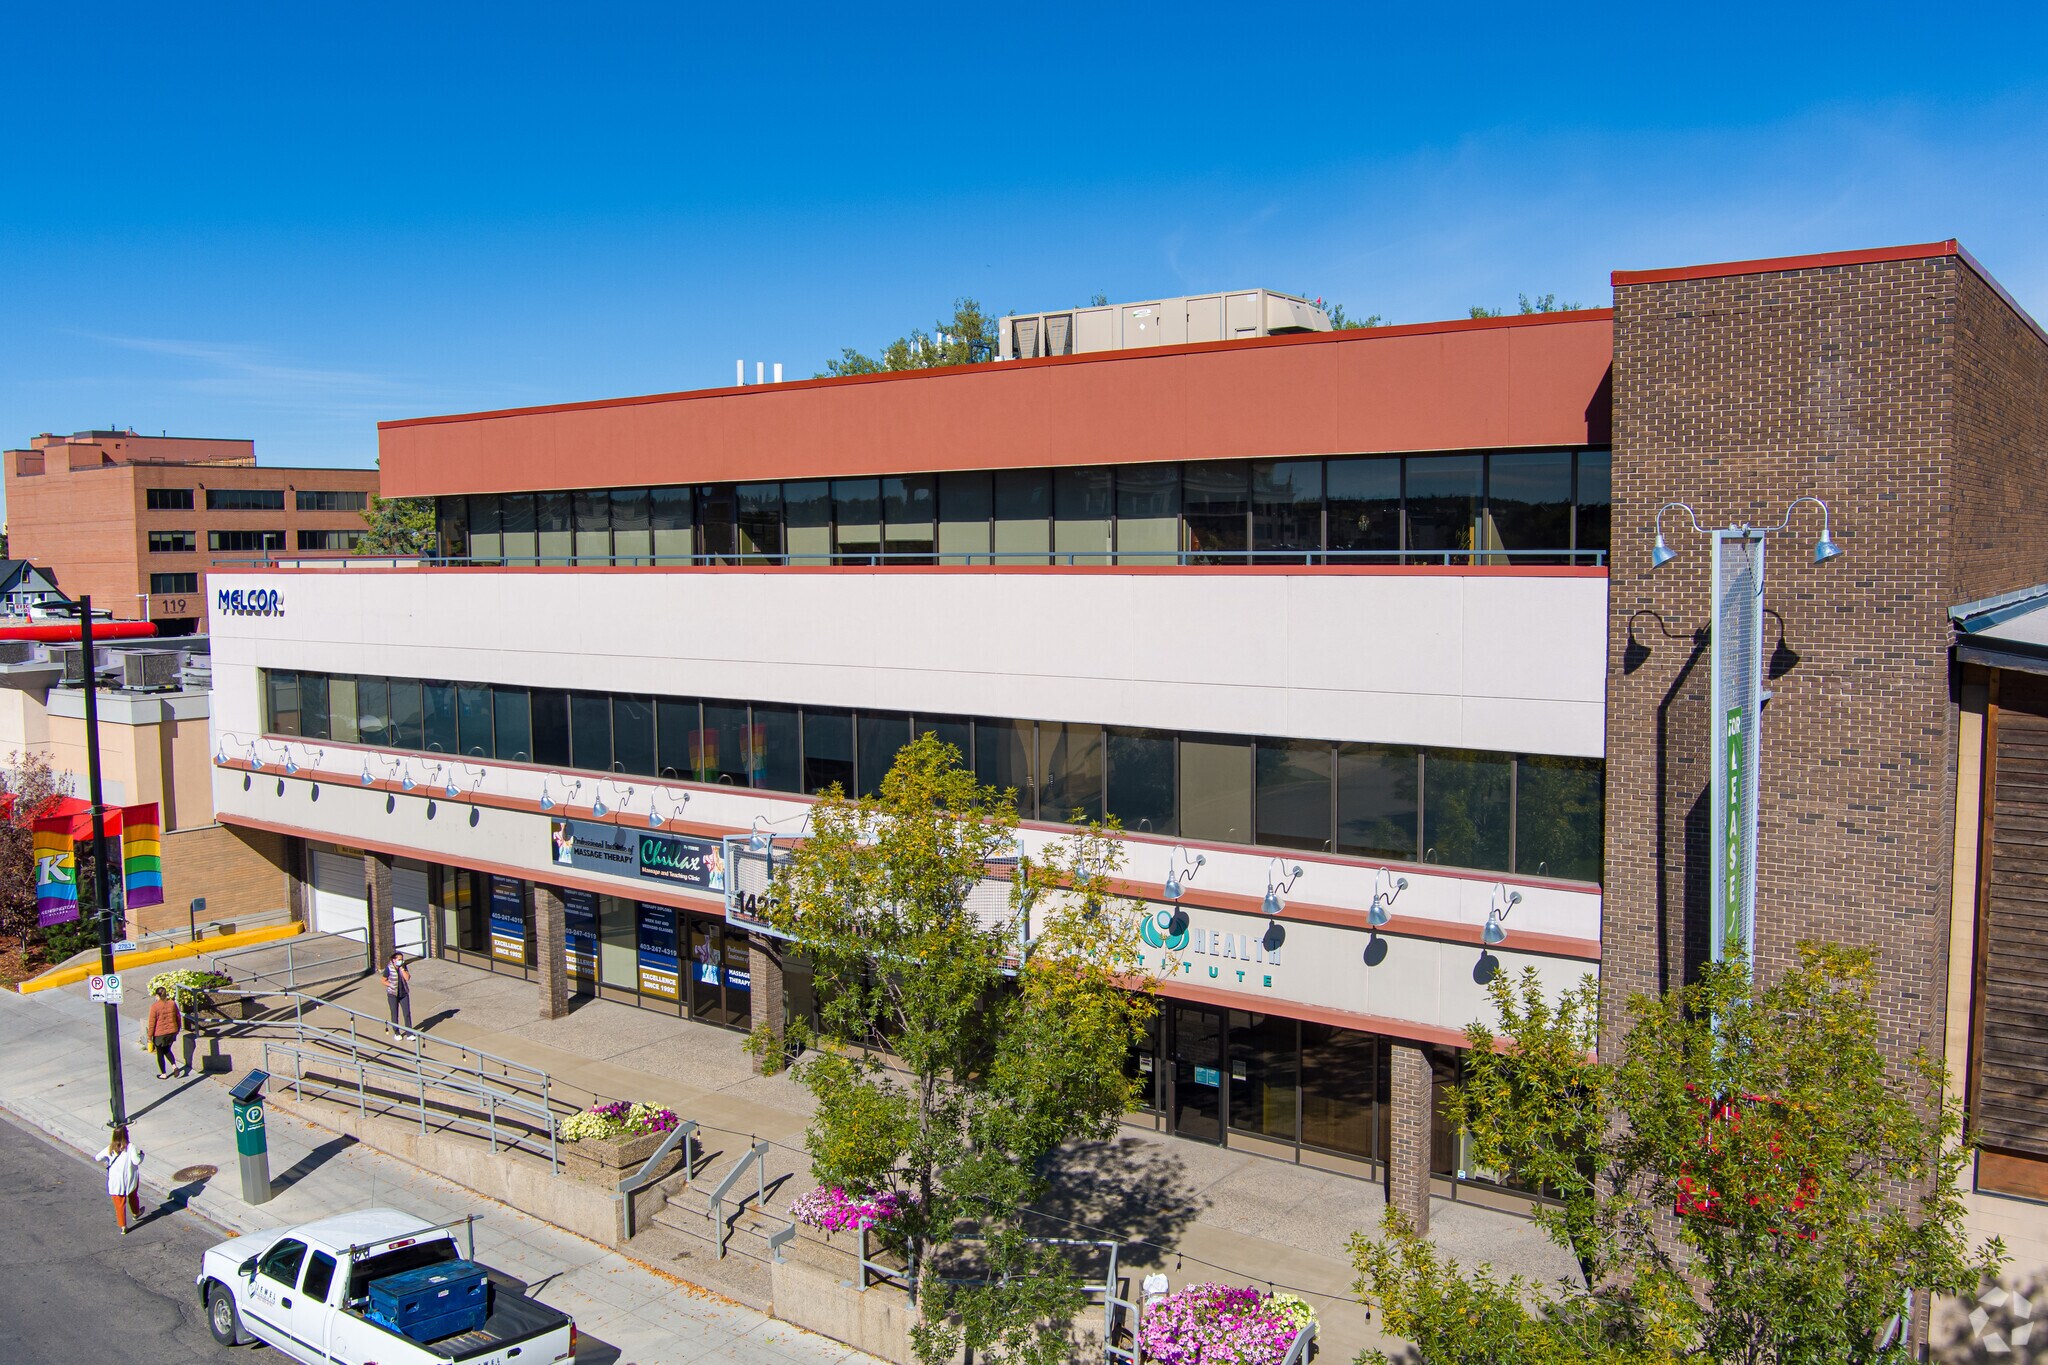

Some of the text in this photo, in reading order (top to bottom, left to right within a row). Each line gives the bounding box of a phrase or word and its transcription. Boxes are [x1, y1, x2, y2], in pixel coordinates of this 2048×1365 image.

[162, 598, 186, 611] 119
[218, 588, 279, 611] MELCOR
[574, 847, 633, 864] MASSAGE THERAPY
[640, 839, 701, 870] Chillax
[37, 853, 71, 885] K
[641, 867, 660, 876] Massage
[661, 869, 669, 877] and
[565, 928, 597, 939] 03-247-4319
[494, 939, 523, 951] EXCELLENCE
[495, 947, 509, 956] SINCE
[640, 943, 678, 956] 403-247-4319
[1194, 928, 1281, 966] HEALTH
[642, 972, 677, 986] EXCELLENCE
[643, 981, 659, 990] SINCE
[729, 976, 750, 987] THERAPY
